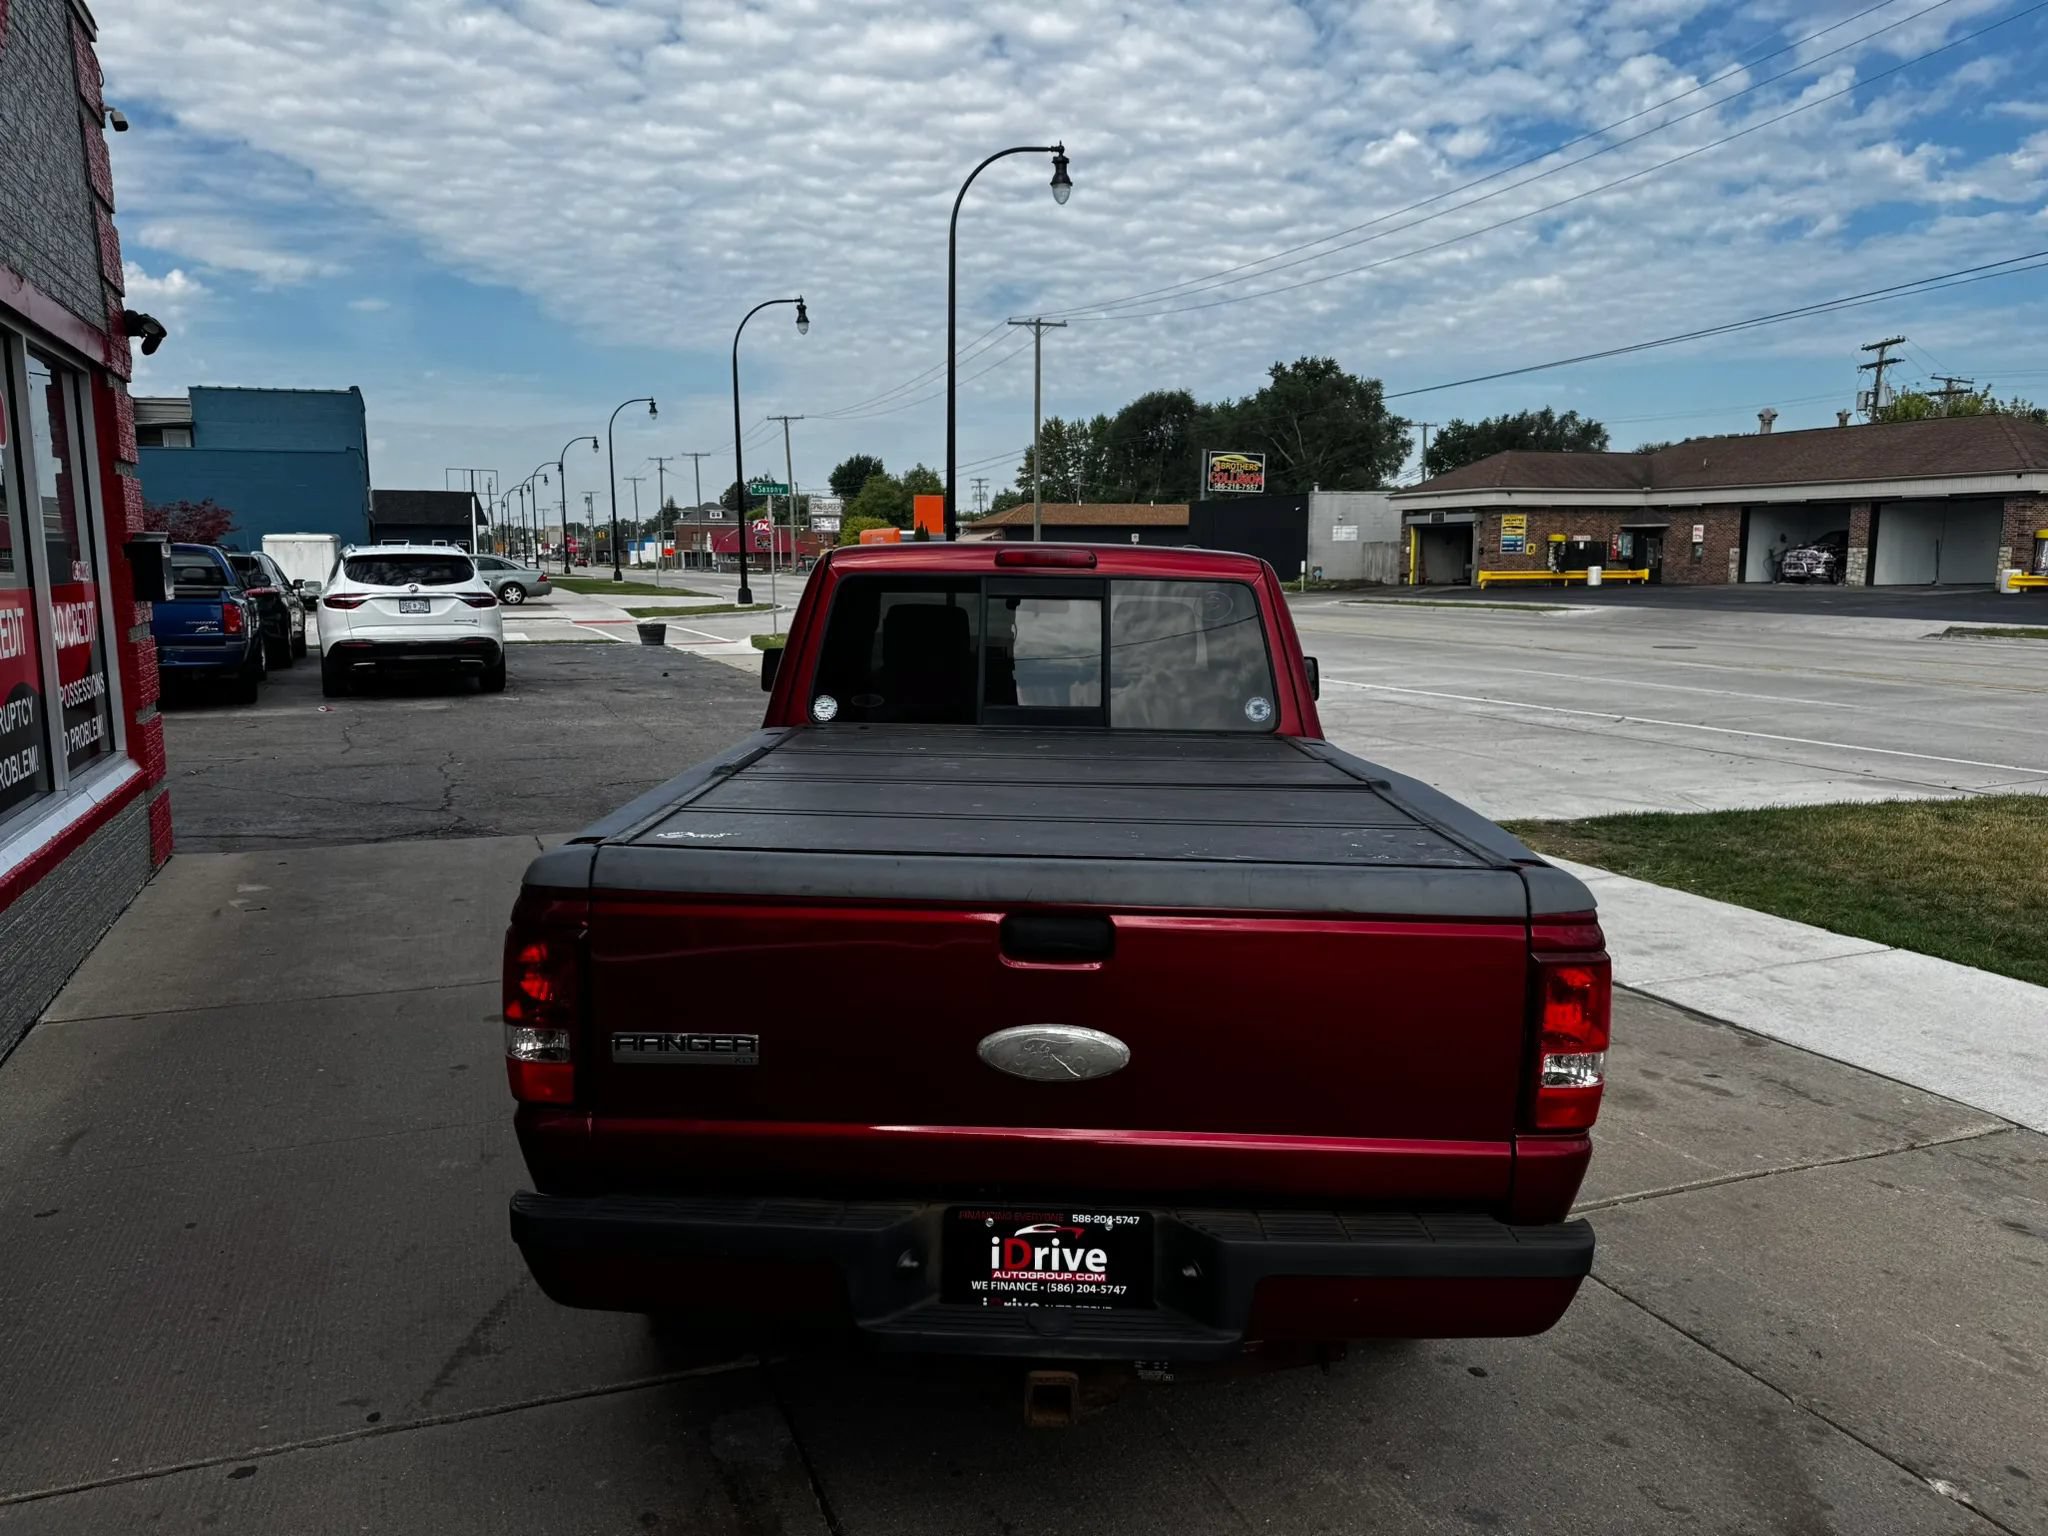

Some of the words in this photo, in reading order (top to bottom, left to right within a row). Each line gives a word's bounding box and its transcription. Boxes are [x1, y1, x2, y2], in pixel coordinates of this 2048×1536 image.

[1220, 462, 1259, 472] BROTHERS
[1210, 472, 1263, 485] COLLISION
[757, 486, 784, 495] Saxony
[65, 601, 96, 648] CREDIT
[0, 607, 26, 660] EDIT
[71, 713, 105, 751] PROBLEM!
[613, 1034, 756, 1053] RANGER
[959, 1211, 1012, 1221] FINANCING
[1014, 1212, 1064, 1222] EVERYONE
[1072, 1214, 1140, 1225] 586-204-5747
[991, 1236, 1108, 1273] iDrive
[992, 1271, 1107, 1282] AUTOGROUP.COM
[971, 1280, 988, 1290] WE
[991, 1281, 1038, 1292] FINANCE
[1047, 1283, 1074, 1294] (586)
[1076, 1284, 1127, 1295] 204-5747
